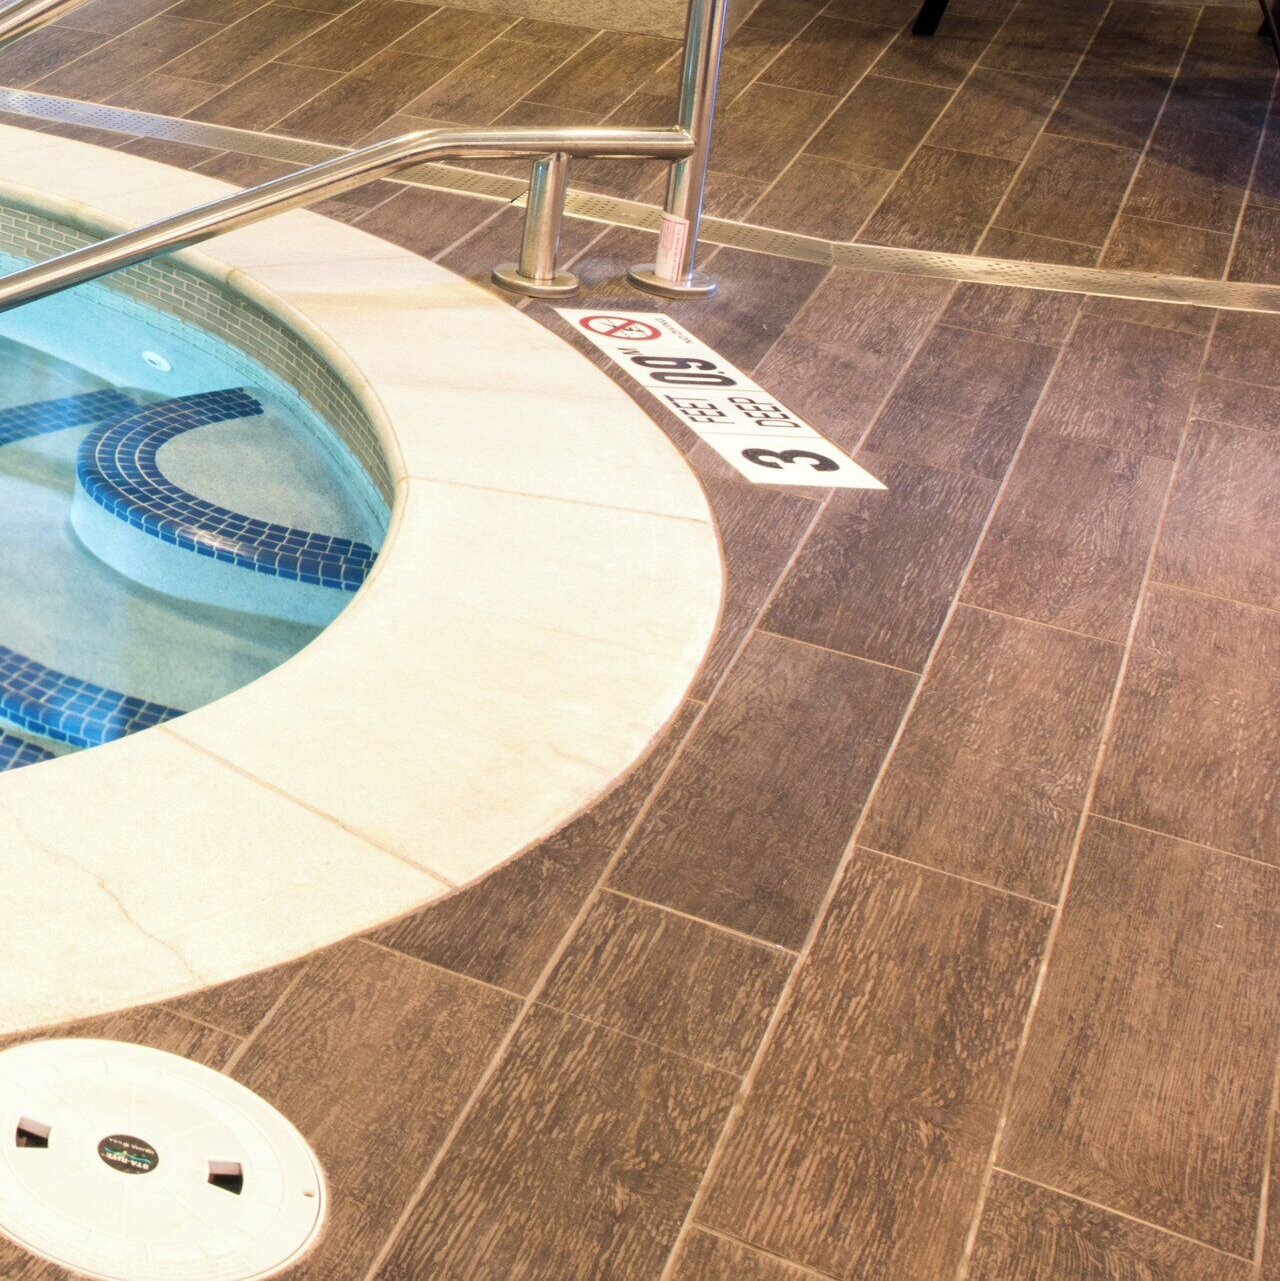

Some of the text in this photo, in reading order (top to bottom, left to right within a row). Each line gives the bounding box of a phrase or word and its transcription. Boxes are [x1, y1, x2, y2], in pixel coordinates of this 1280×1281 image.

[664, 394, 736, 426] FEET
[729, 396, 803, 429] DEEP
[741, 447, 840, 473] 3
